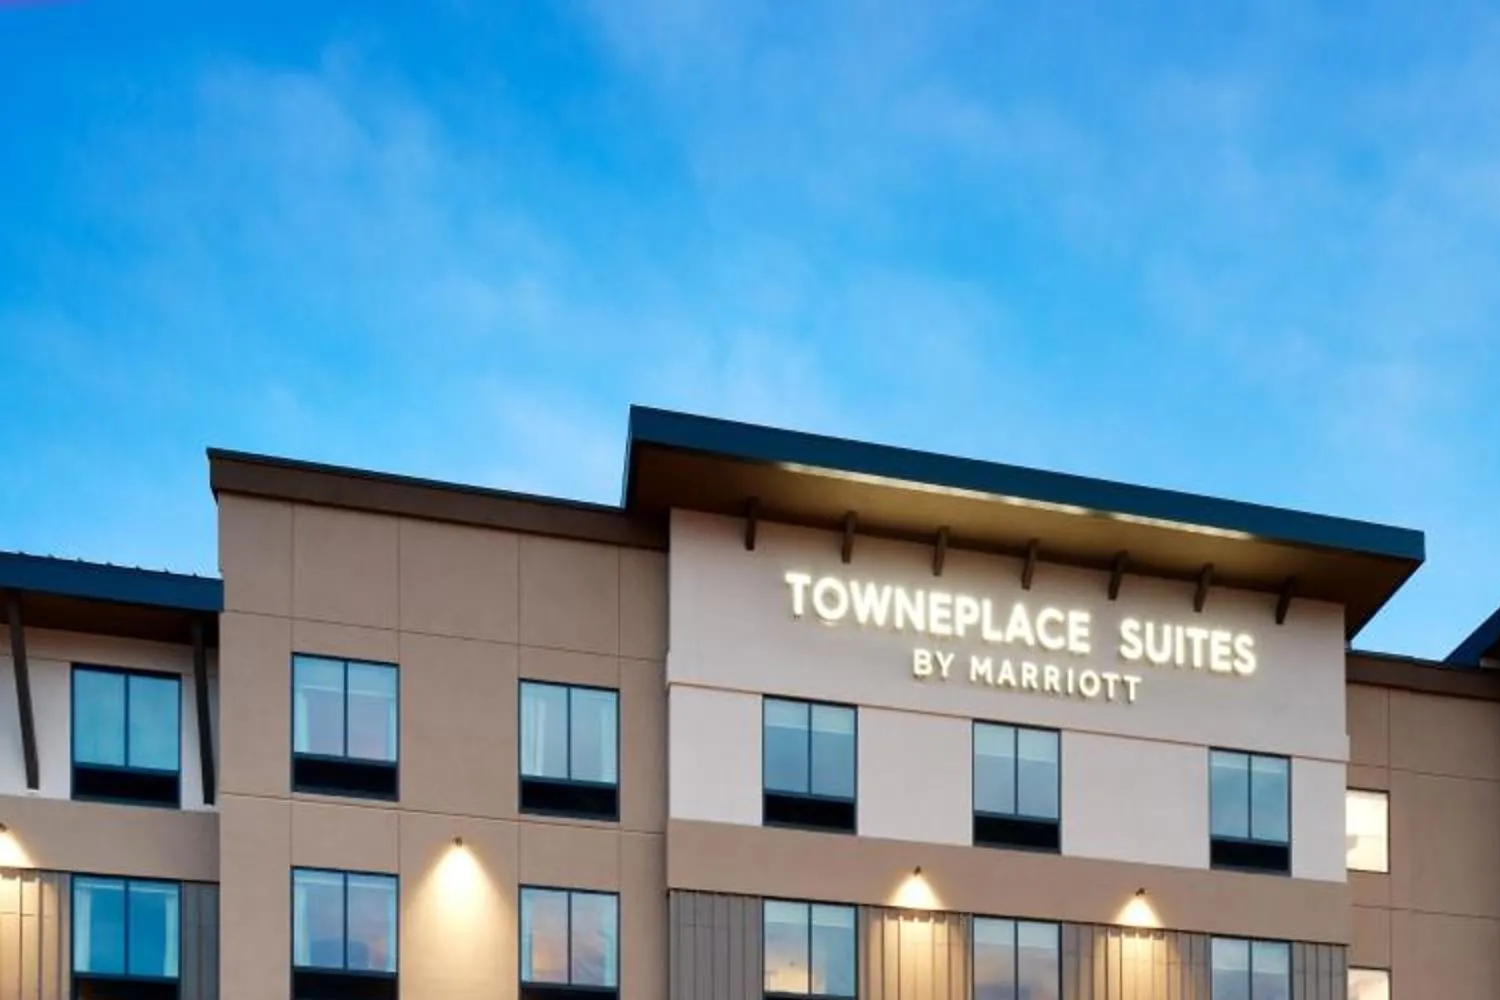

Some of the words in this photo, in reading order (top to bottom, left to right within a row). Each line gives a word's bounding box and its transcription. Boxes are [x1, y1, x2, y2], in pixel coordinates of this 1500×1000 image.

[784, 572, 1092, 653] TOWNEPLACE
[1118, 617, 1257, 674] SUITES
[913, 647, 953, 677] BY
[969, 657, 1142, 701] MARRIOTT
